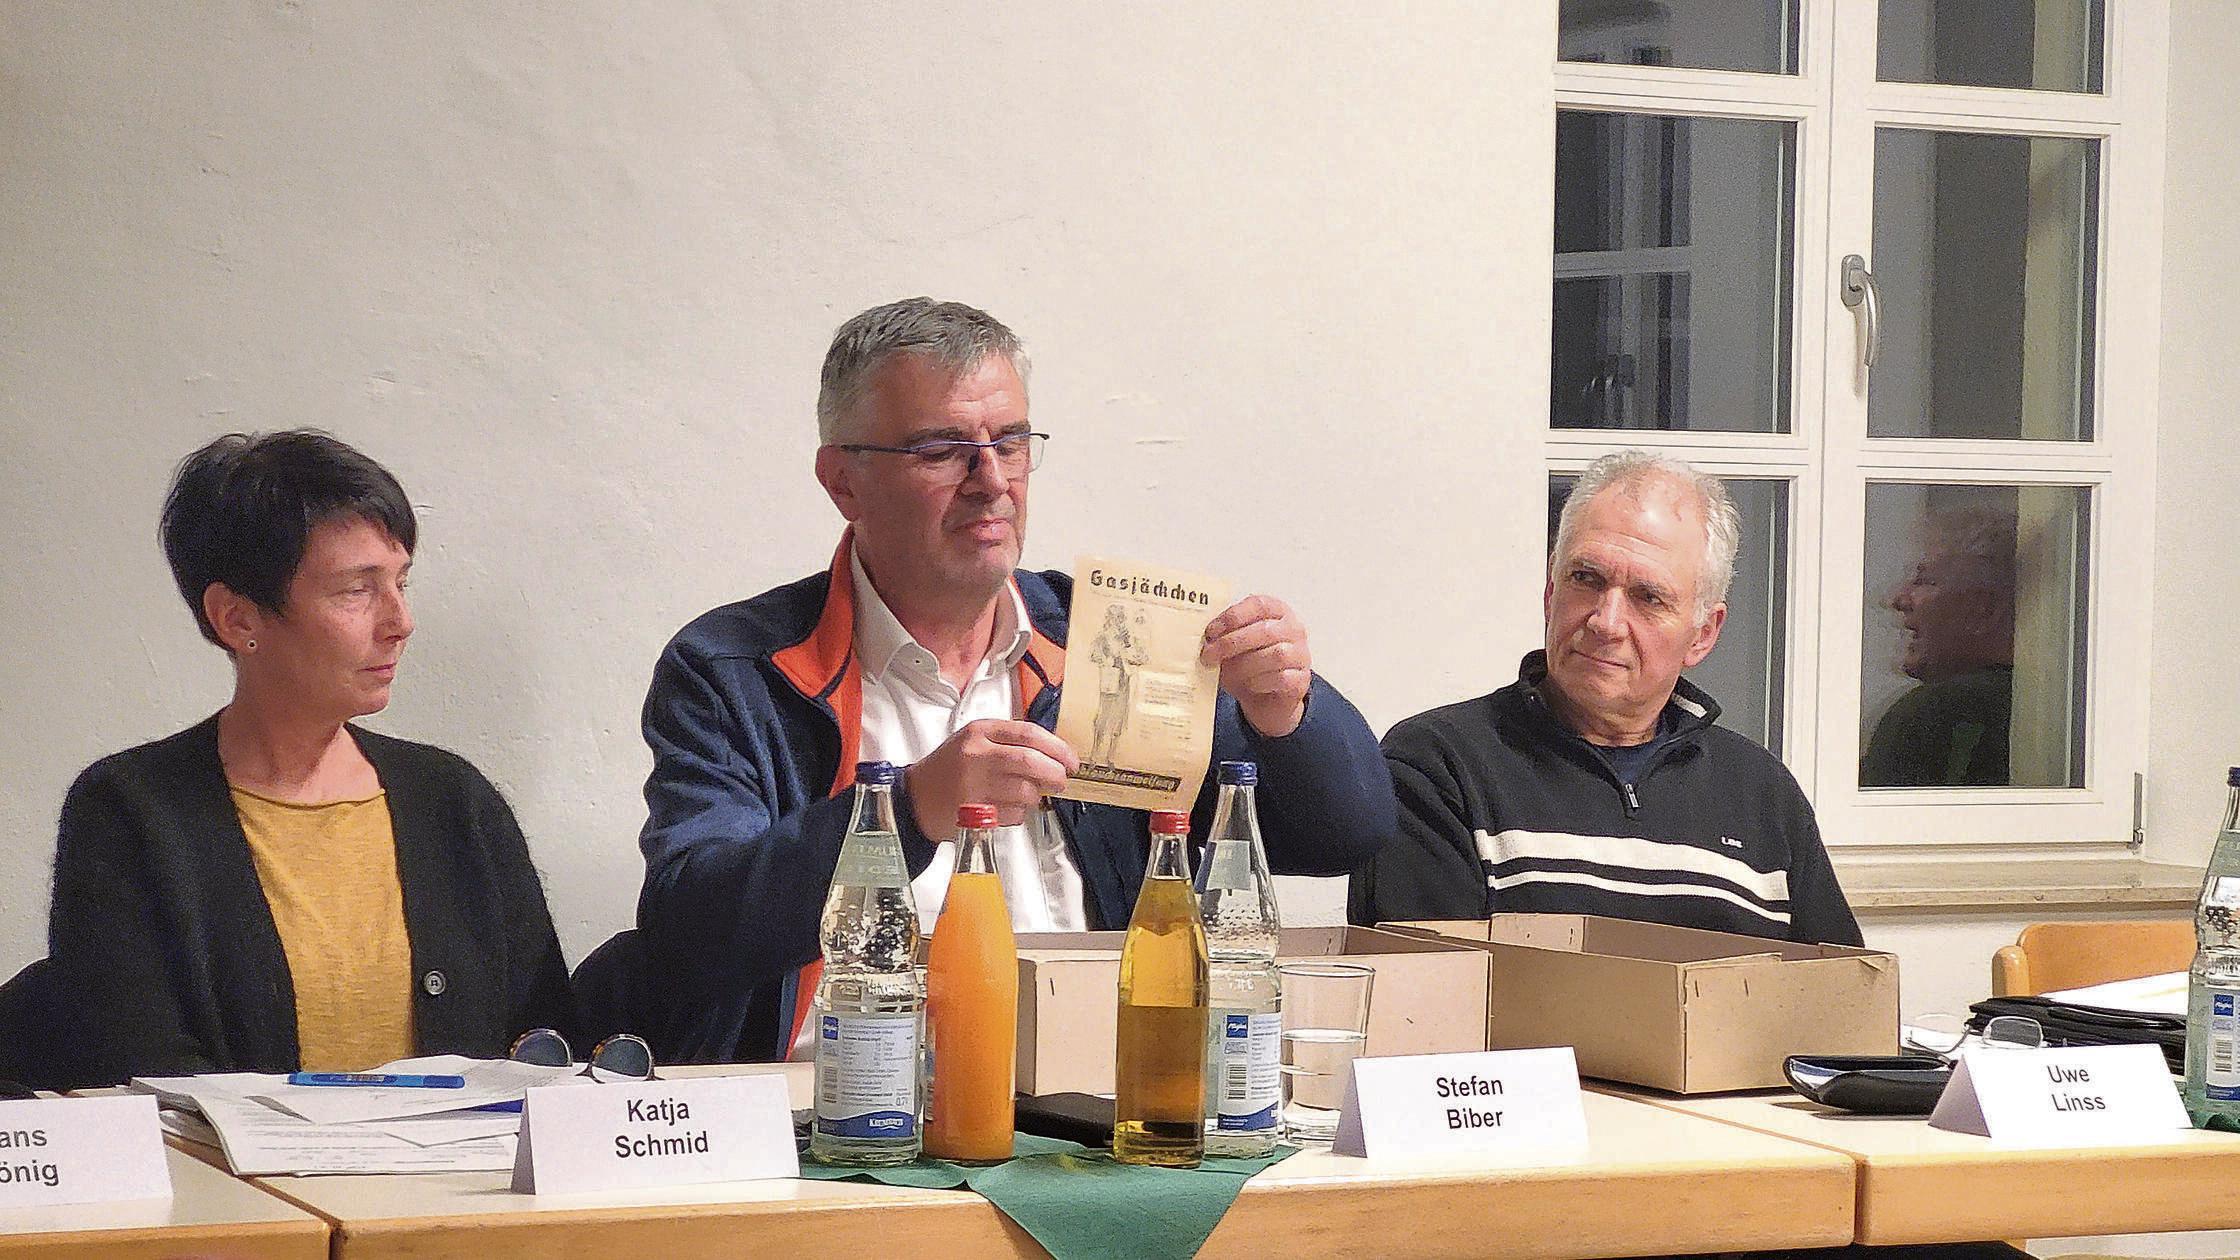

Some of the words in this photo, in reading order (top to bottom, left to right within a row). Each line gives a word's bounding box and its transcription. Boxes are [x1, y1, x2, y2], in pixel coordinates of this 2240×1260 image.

[1090, 569, 1209, 605] Gasjäckchen
[2046, 1065, 2090, 1083] Uwe
[1436, 1075, 1503, 1098] Stefan
[627, 1097, 690, 1126] Katja
[2051, 1093, 2106, 1111] Linss
[1446, 1107, 1503, 1129] Biber
[0, 1130, 48, 1148] ans
[614, 1130, 709, 1158] Schmid
[0, 1159, 60, 1187] önig
